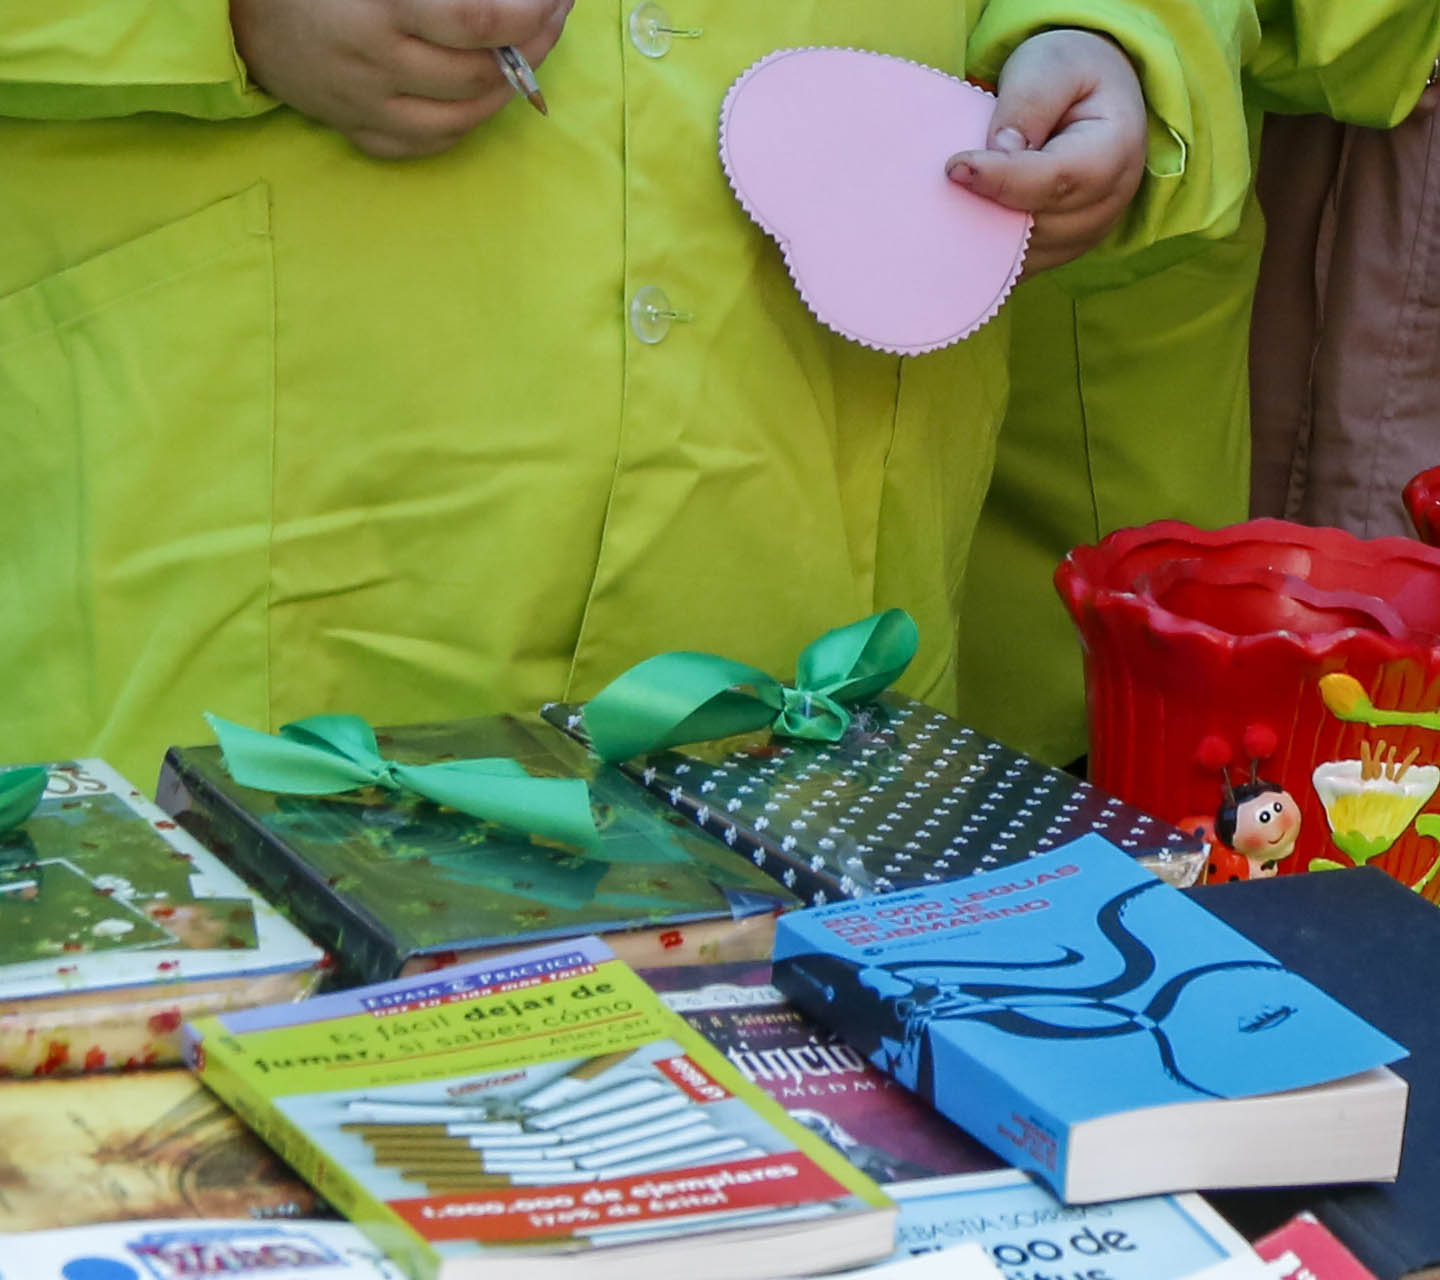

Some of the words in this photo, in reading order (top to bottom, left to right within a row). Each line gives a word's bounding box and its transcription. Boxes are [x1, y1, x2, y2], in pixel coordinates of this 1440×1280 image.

[951, 864, 1081, 904] LEGUAS
[833, 923, 883, 938] DE
[887, 903, 988, 927] VIAJE
[846, 898, 1051, 946] SUBMARINO
[464, 994, 555, 1022] dejar
[571, 983, 616, 1000] de
[1070, 1226, 1137, 1256] de
